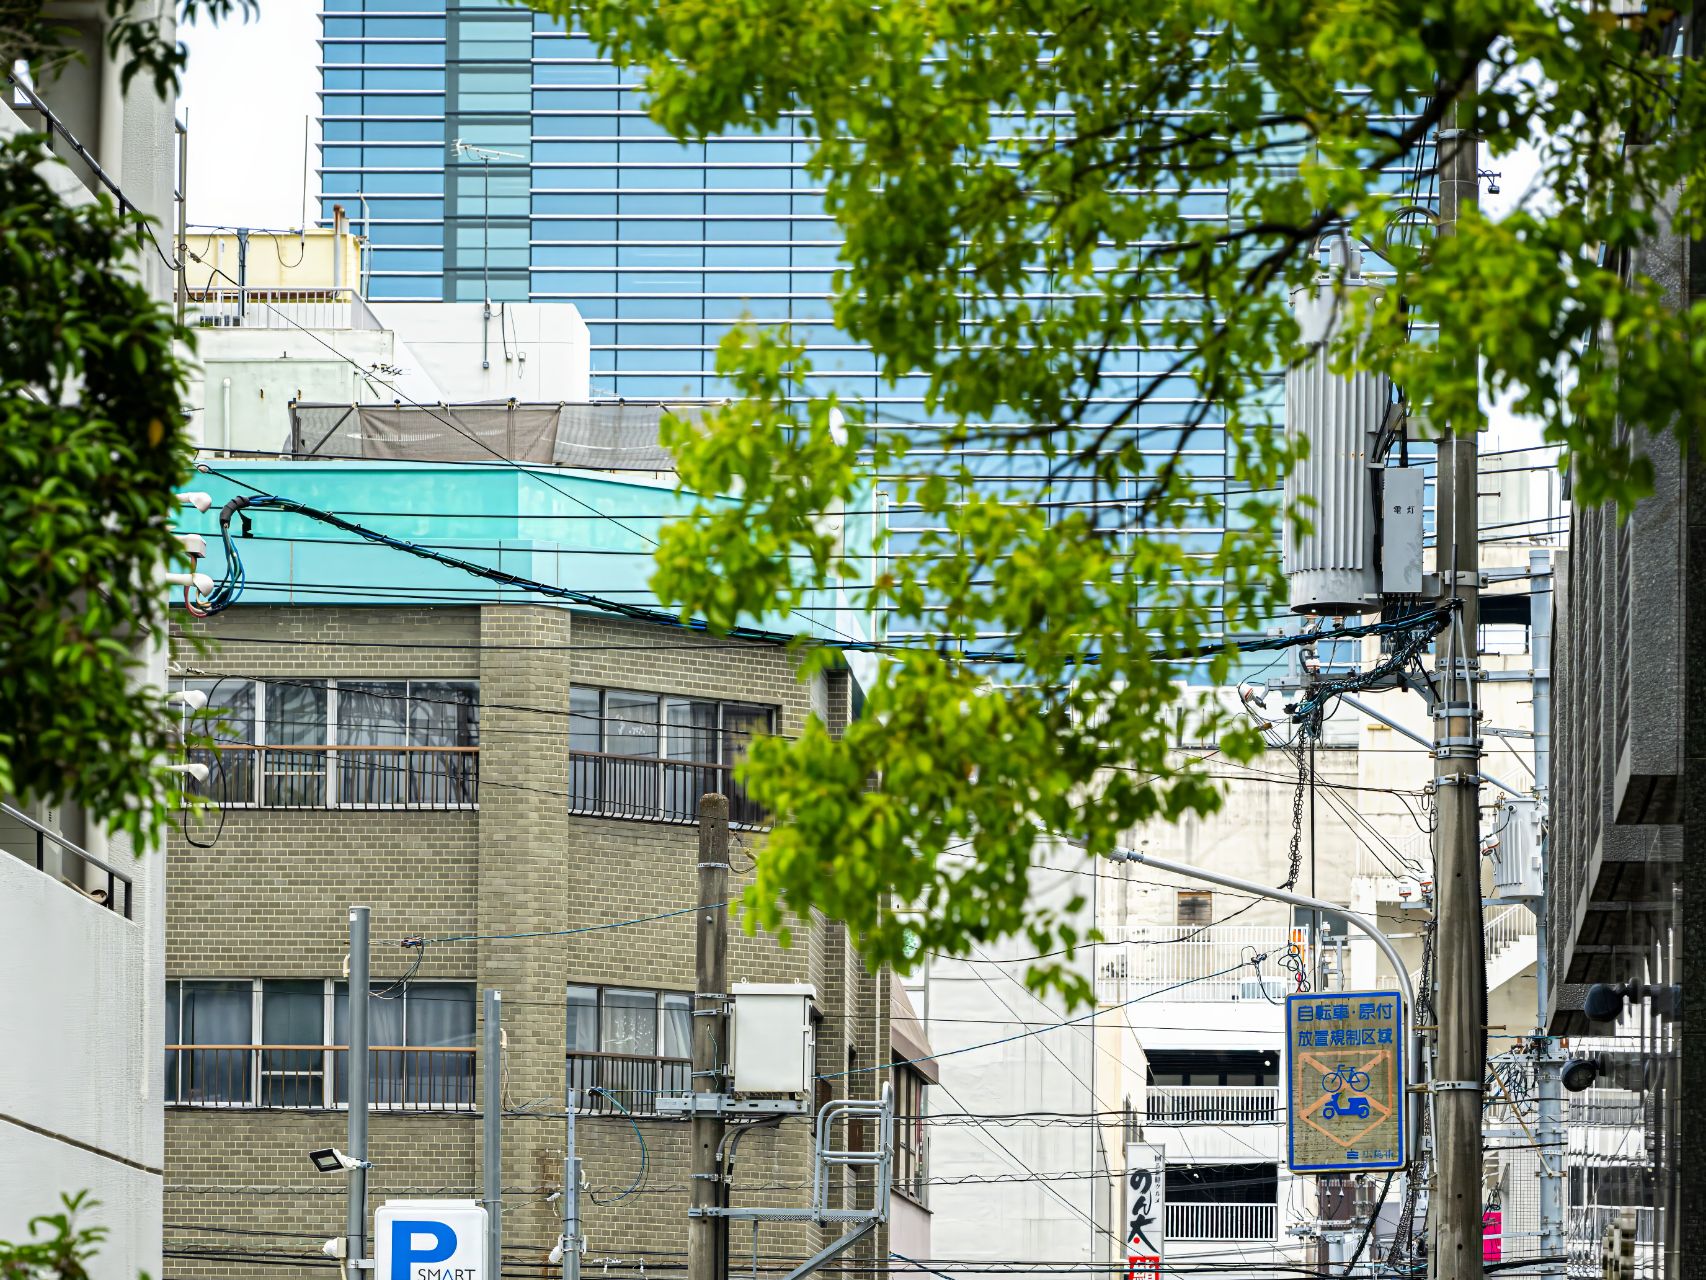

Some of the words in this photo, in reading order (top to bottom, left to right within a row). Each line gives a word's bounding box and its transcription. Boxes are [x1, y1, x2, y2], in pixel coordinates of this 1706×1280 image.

[1393, 505, 1415, 515] 電灯
[1298, 1028, 1393, 1047] 放置規制区域
